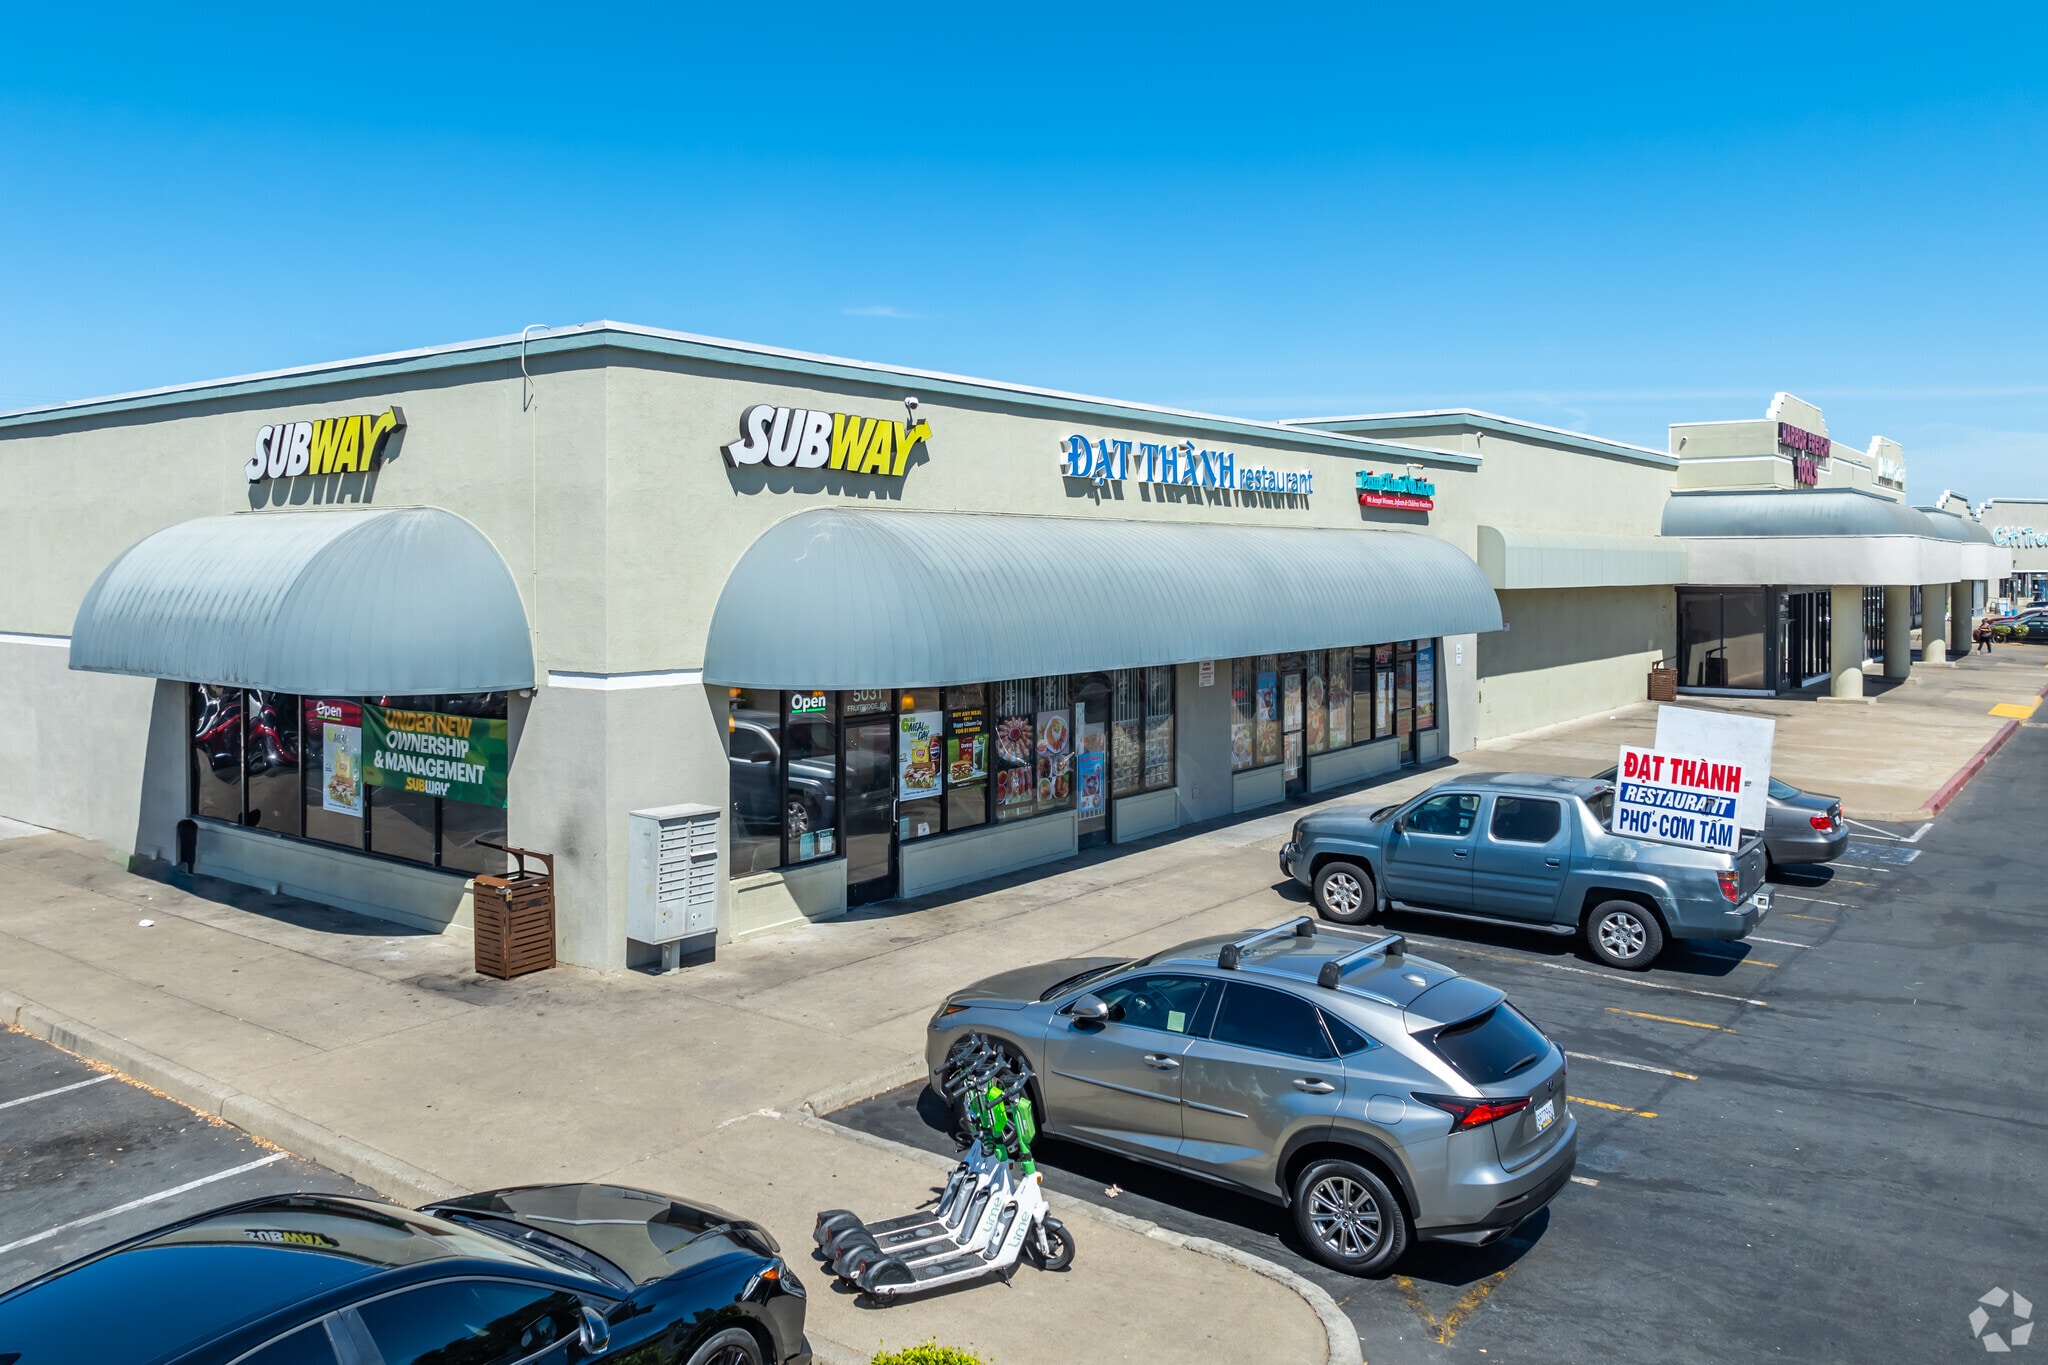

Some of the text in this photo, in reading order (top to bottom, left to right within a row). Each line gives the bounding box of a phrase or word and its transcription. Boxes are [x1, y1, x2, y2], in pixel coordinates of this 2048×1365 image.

[245, 406, 397, 483] SUBWAY
[729, 404, 933, 477] SUBWAY
[1782, 422, 1807, 450] HARBOR
[1068, 434, 1314, 494] ĐẠT THÀNH restaurant
[1798, 456, 1818, 486] TOOLS
[1993, 526, 2048, 546] CitiTre
[316, 700, 342, 718] Open
[792, 694, 826, 711] Open
[384, 710, 473, 738] UNDER NEW
[386, 730, 470, 759] OWNERSHIP
[374, 750, 486, 785] & MANAGEMENT
[1624, 751, 1742, 793] ĐẠT THÀNH
[405, 776, 451, 796] SUBWAY
[1659, 814, 1695, 841] CƠM
[1700, 818, 1733, 847] TẤM
[982, 1197, 1001, 1232] Lime
[1007, 1211, 1029, 1248] Lime
